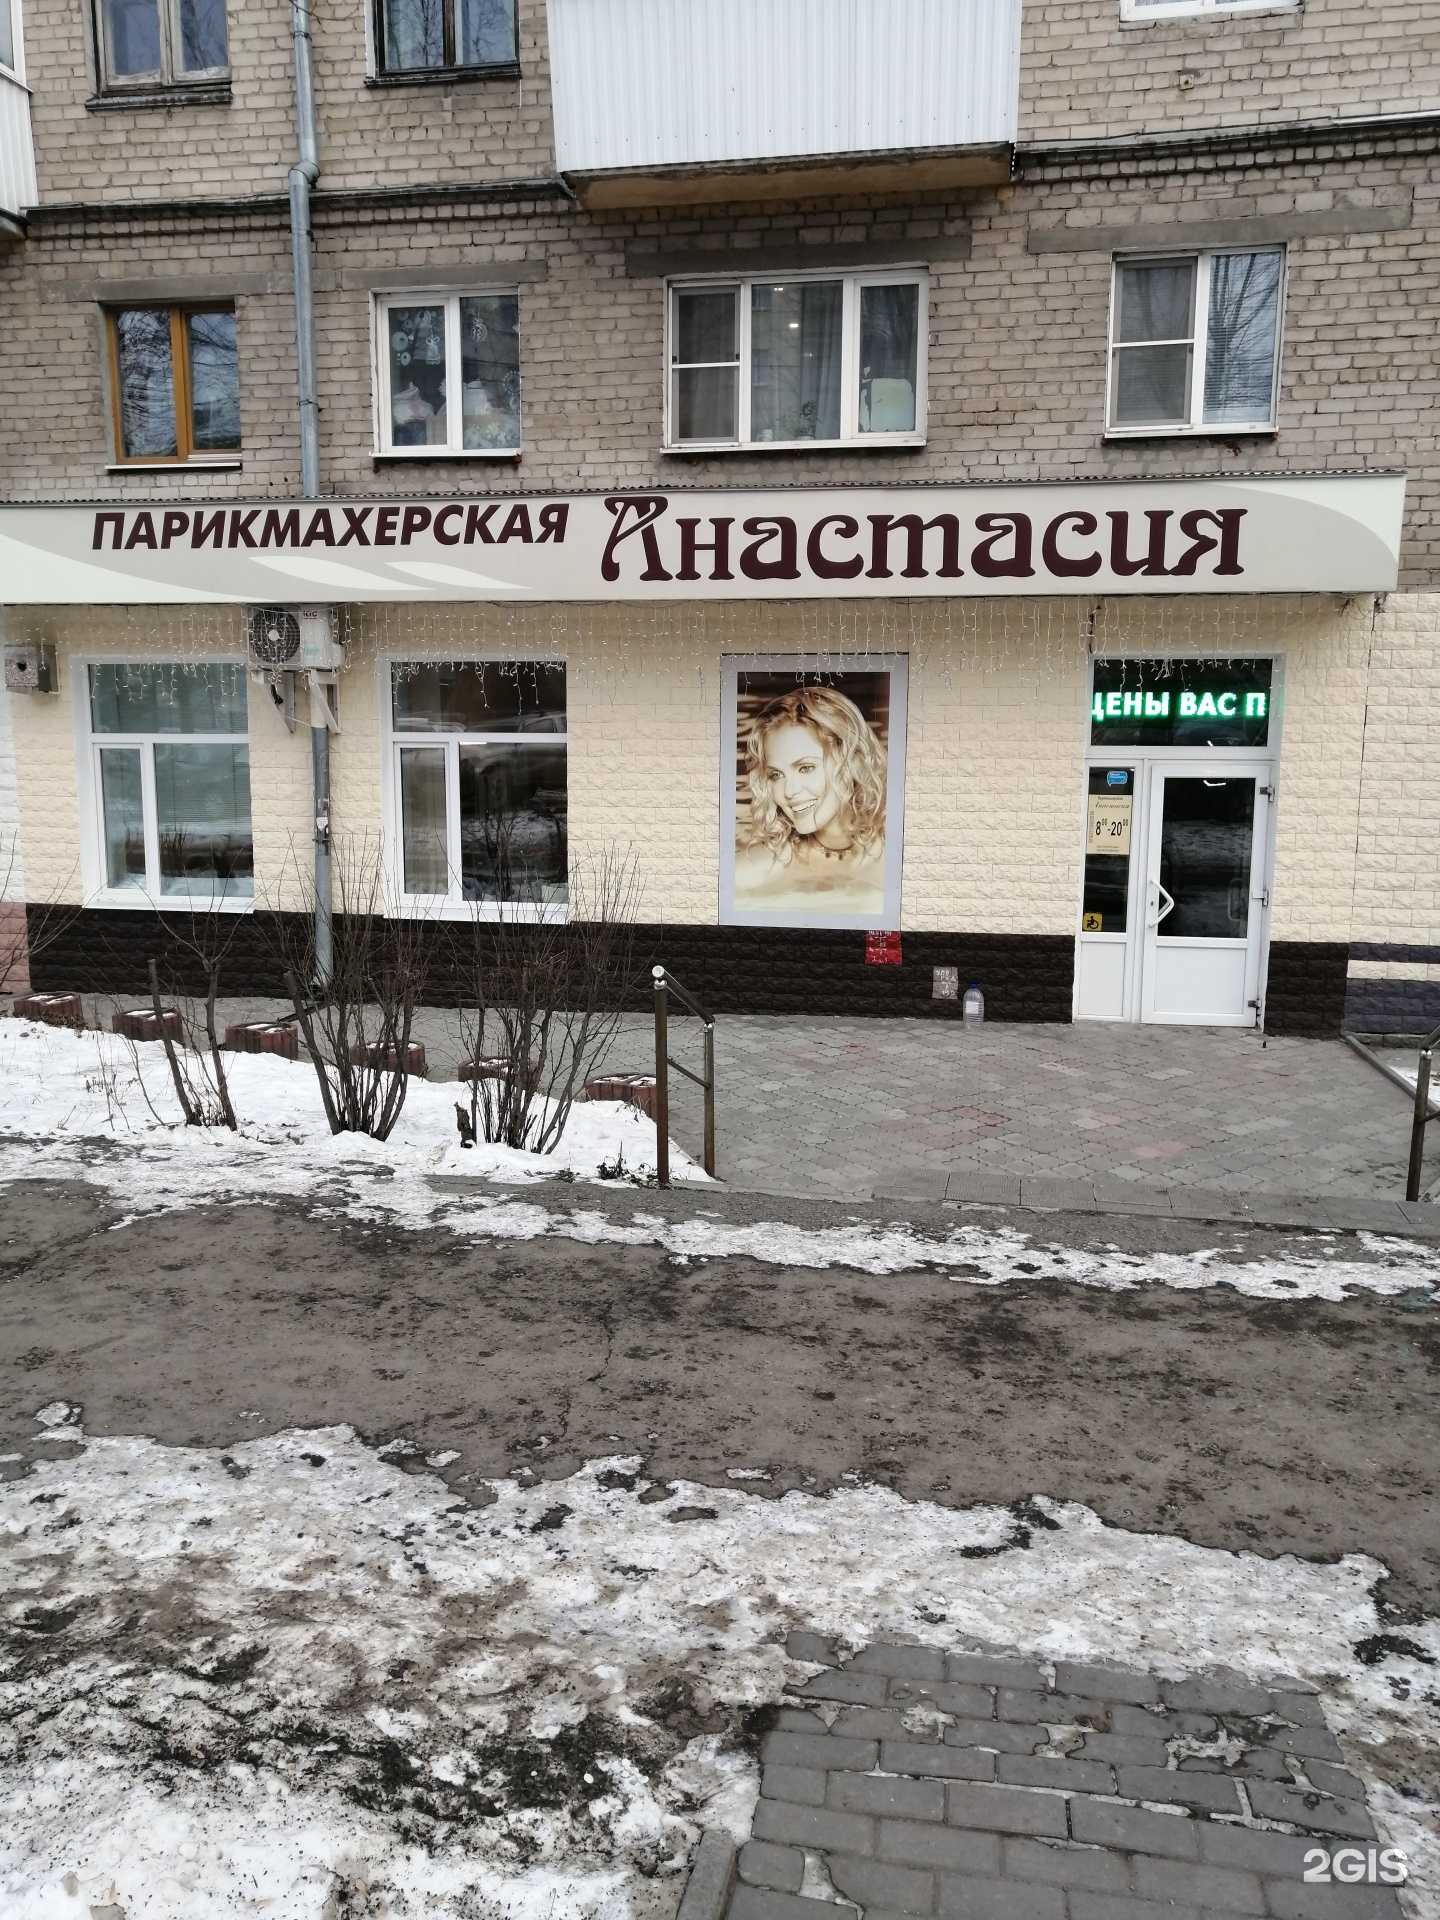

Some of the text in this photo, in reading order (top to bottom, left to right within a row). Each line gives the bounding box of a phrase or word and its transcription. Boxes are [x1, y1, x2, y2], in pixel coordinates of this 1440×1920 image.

[93, 496, 1247, 582] ПАРИКМАХЕРСКАЯ Анастасия
[1180, 692, 1237, 716] ВАС
